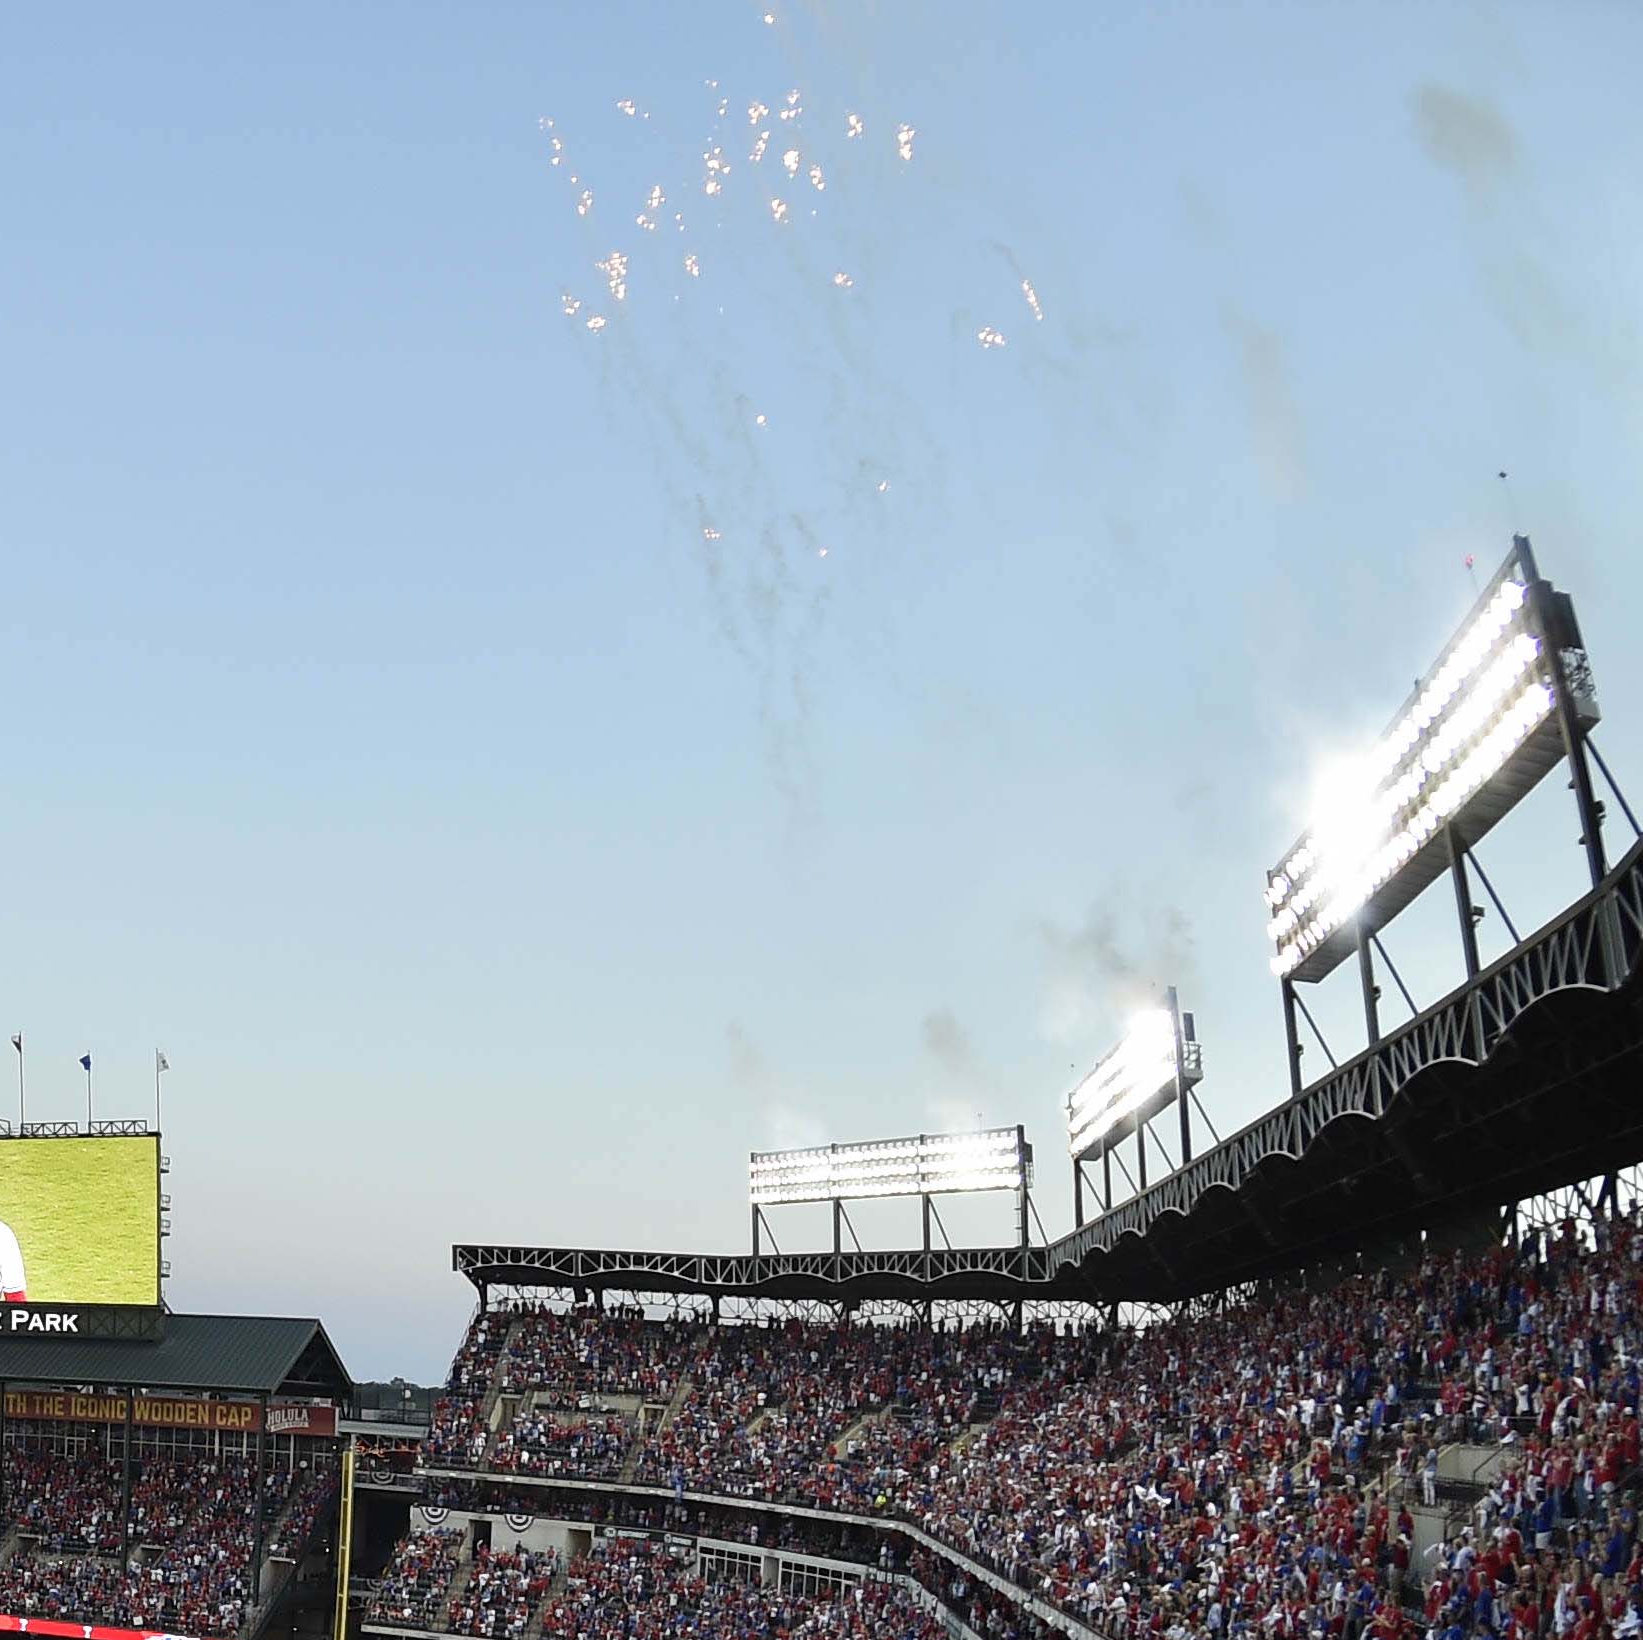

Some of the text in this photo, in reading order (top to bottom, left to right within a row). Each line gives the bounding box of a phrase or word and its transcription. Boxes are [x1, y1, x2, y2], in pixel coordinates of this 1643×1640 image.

[11, 1310, 79, 1333] PARK
[33, 1395, 64, 1416] THE
[70, 1398, 127, 1419] ICONIC
[134, 1402, 210, 1424] WOODEN
[215, 1406, 252, 1427] CAP
